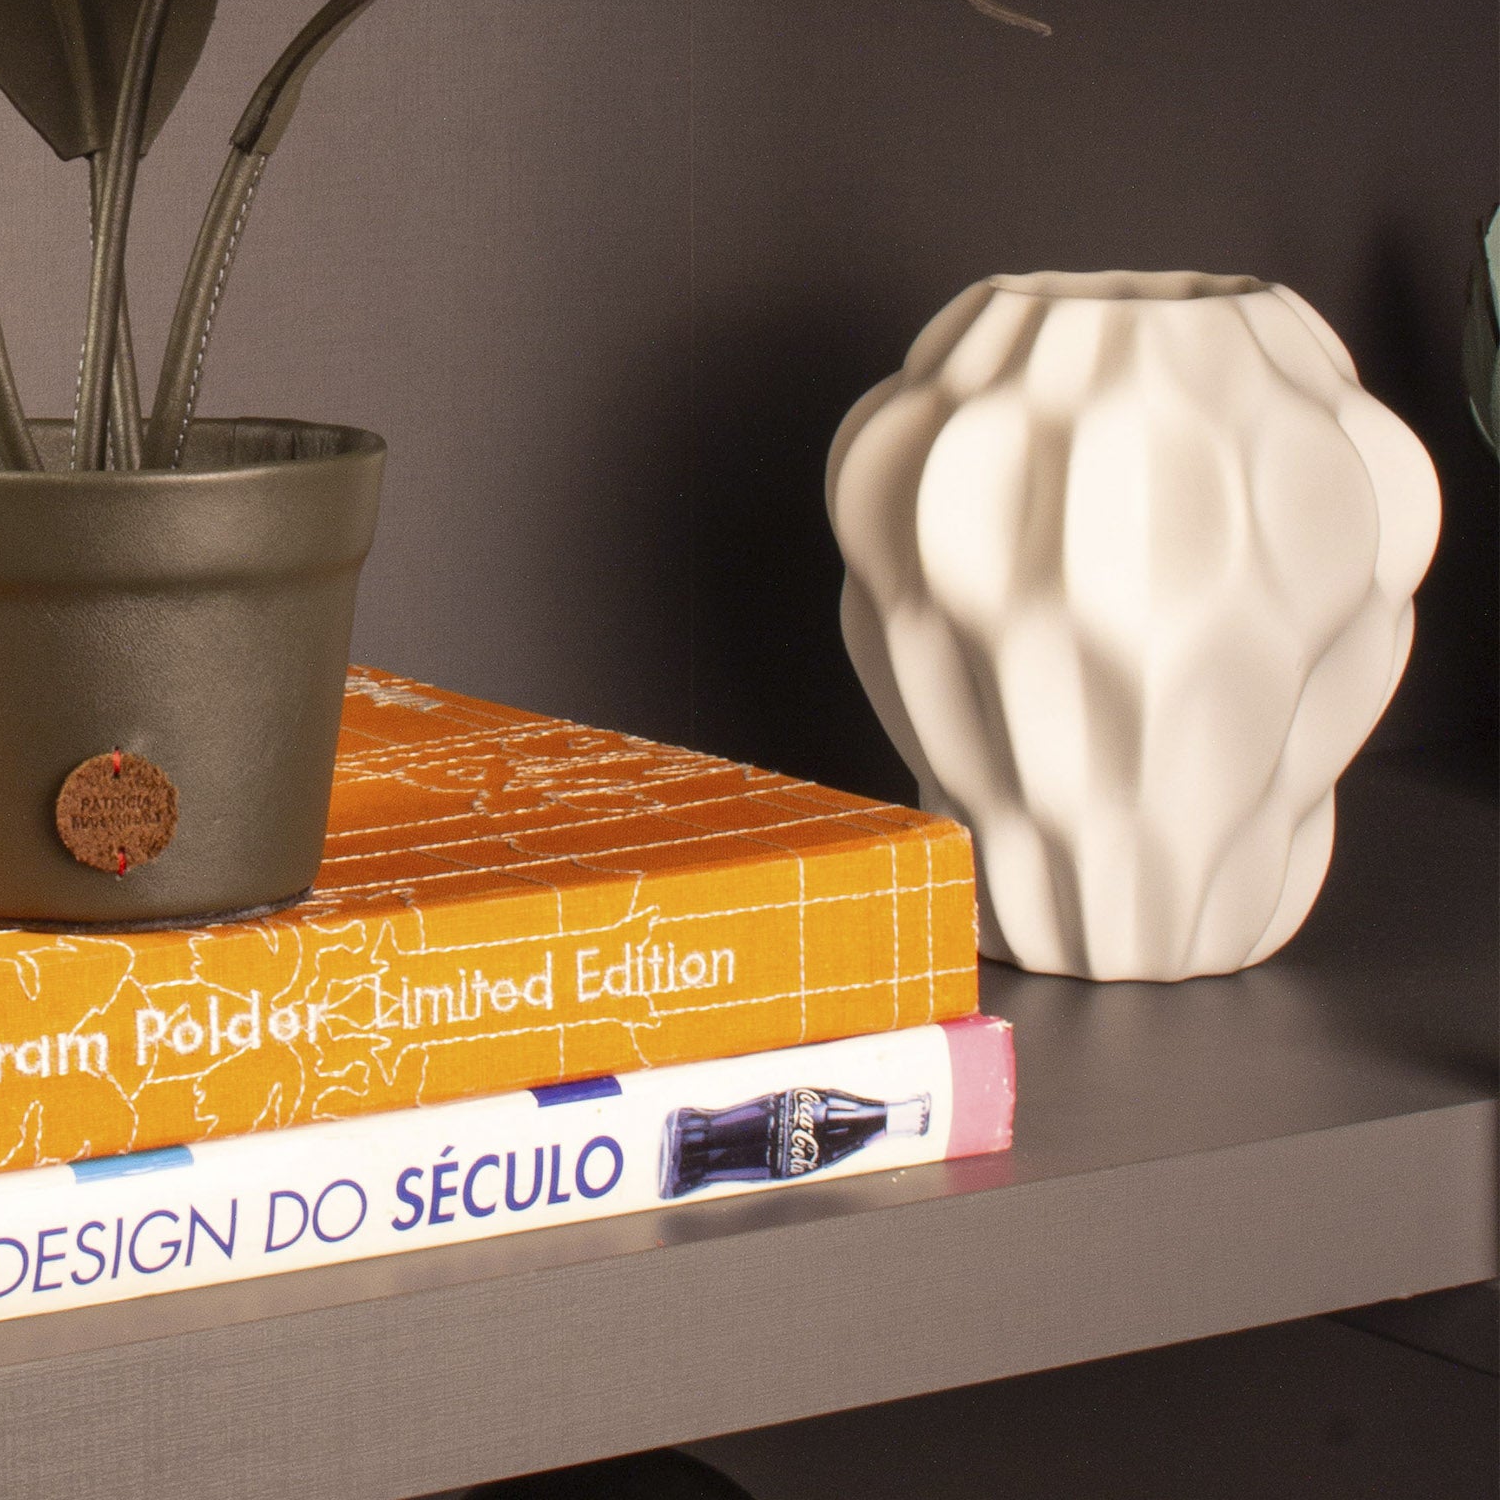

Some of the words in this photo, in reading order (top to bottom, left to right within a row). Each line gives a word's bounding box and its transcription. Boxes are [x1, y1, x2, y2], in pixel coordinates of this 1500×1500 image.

[136, 989, 328, 1066] Polder
[373, 950, 554, 1030] Limited
[576, 942, 735, 1003] Edition
[265, 1178, 367, 1254] DO
[392, 1134, 624, 1232] SÉCULO
